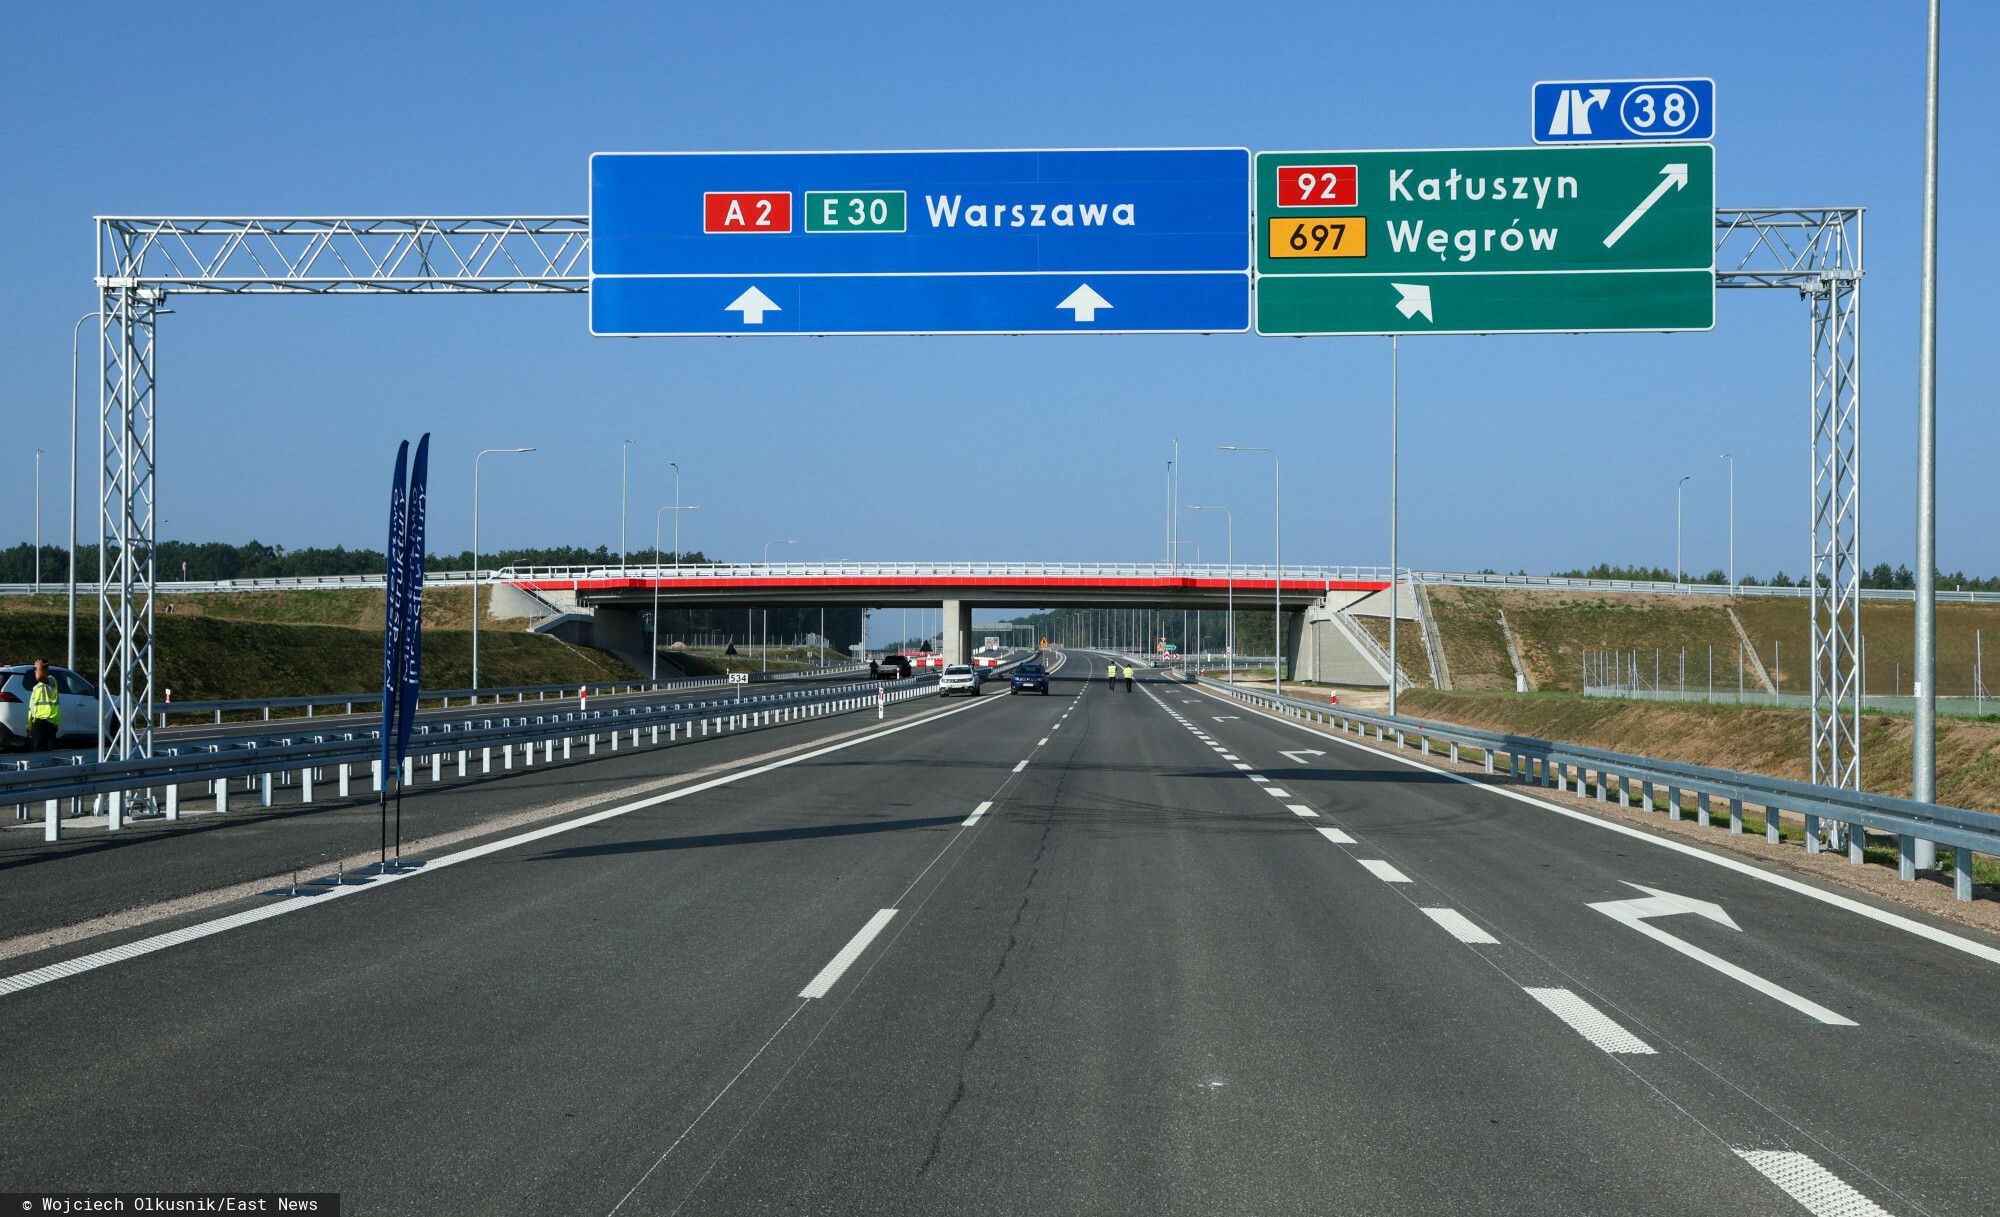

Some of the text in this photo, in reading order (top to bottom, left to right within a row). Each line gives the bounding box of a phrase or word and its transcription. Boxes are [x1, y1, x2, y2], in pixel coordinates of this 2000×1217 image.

[1632, 92, 1687, 128] 38
[1297, 172, 1337, 200] 92
[1389, 168, 1578, 209] Kałuszyn
[823, 198, 888, 226] E 30
[925, 195, 1136, 228] Warszawa
[1289, 223, 1346, 252] 697
[1387, 218, 1559, 262] Węgrów
